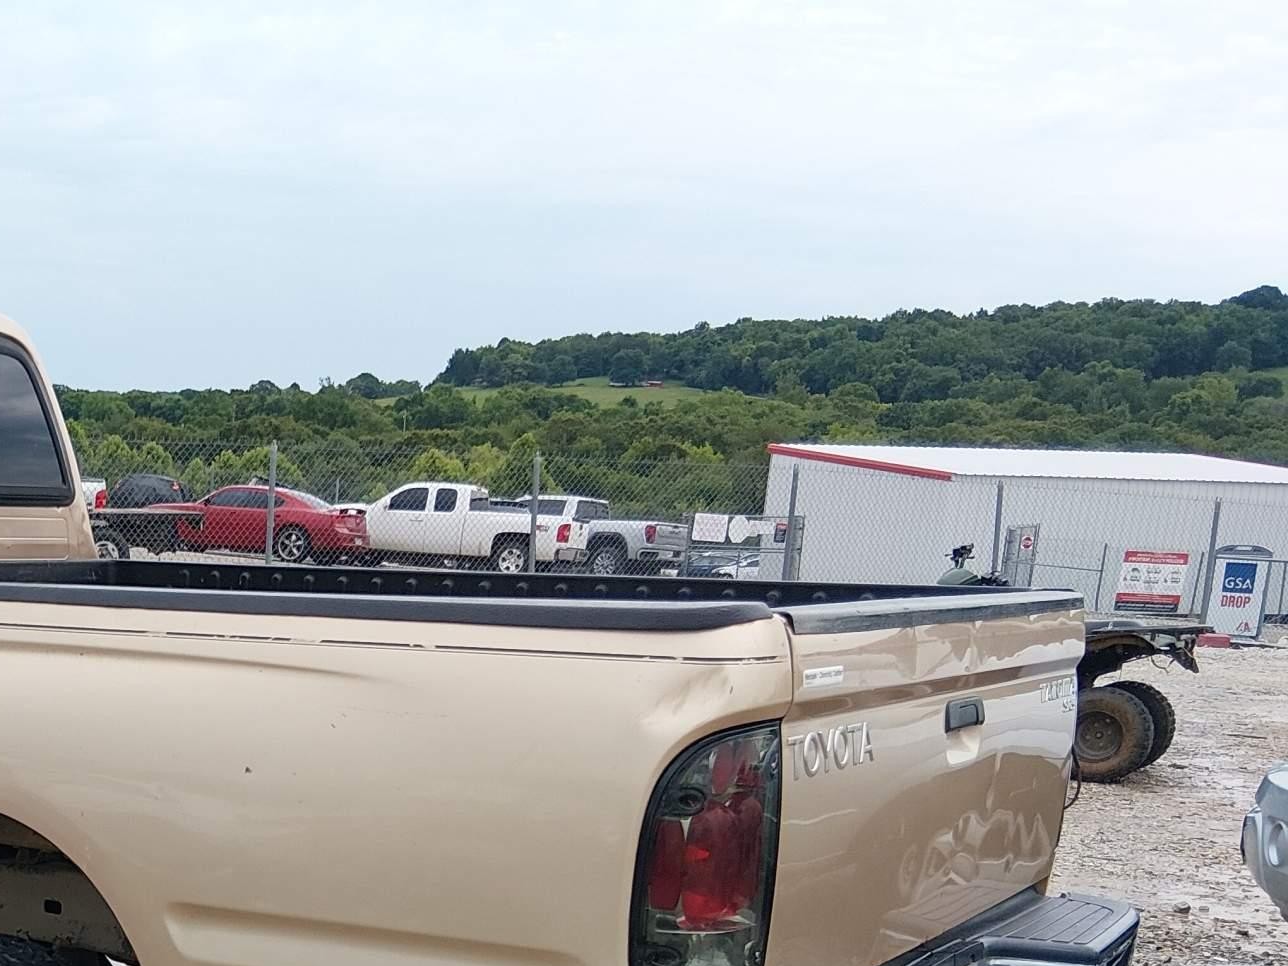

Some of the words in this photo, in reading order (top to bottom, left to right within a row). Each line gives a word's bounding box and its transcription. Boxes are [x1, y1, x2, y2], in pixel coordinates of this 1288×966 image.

[1224, 576, 1252, 590] GSA
[1220, 595, 1251, 609] DROP
[786, 721, 875, 781] TOYOTA
